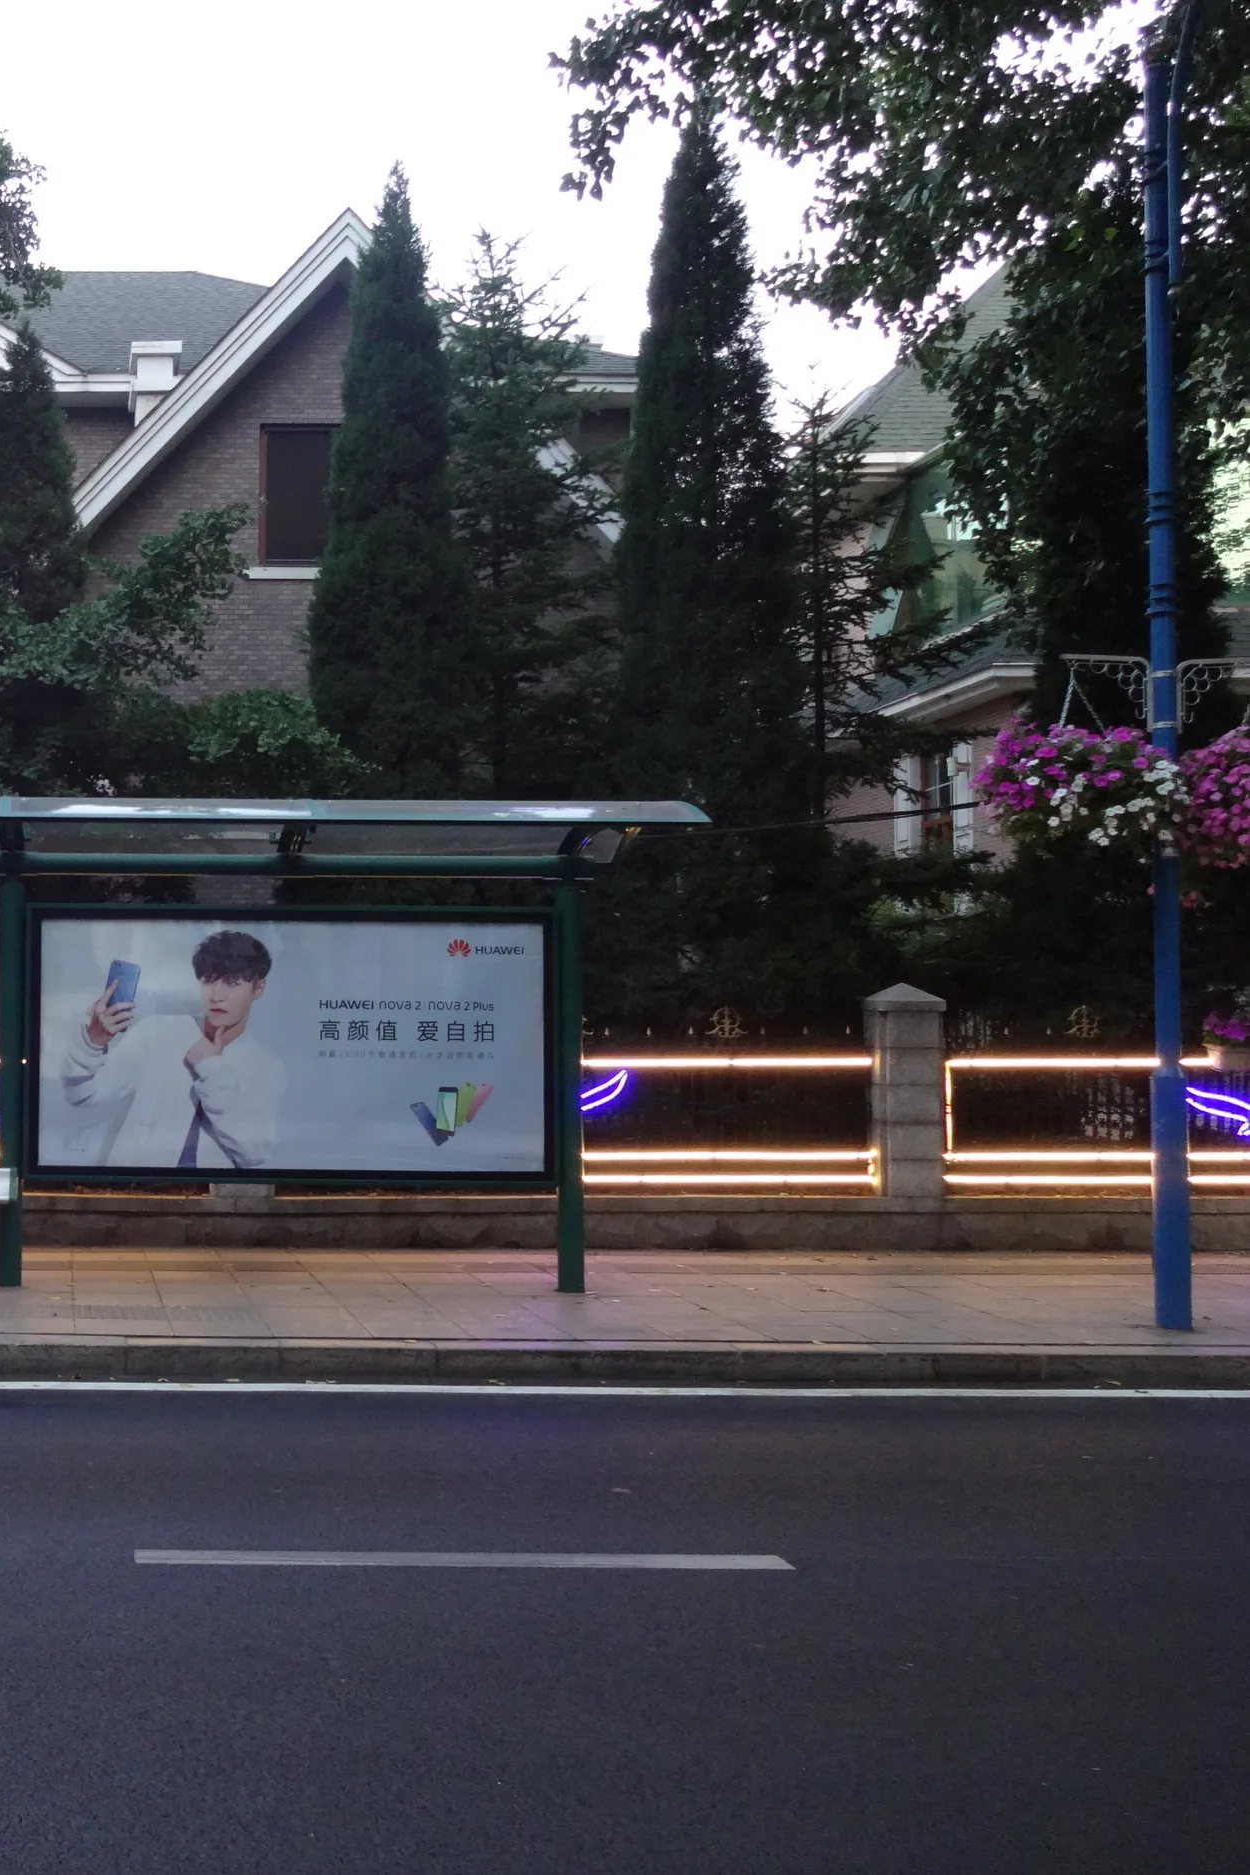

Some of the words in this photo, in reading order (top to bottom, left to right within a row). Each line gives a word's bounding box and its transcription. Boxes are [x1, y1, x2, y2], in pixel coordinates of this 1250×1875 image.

[475, 946, 525, 955] HUAWEI
[319, 999, 374, 1010] HUAWEI
[378, 1001, 412, 1010] nova
[414, 1001, 421, 1011] 2
[428, 1001, 461, 1011] nova
[463, 1001, 470, 1011] 2
[473, 1001, 495, 1012] Plus
[319, 1019, 398, 1041] 高颜值
[417, 1020, 495, 1042] 爱自拍
